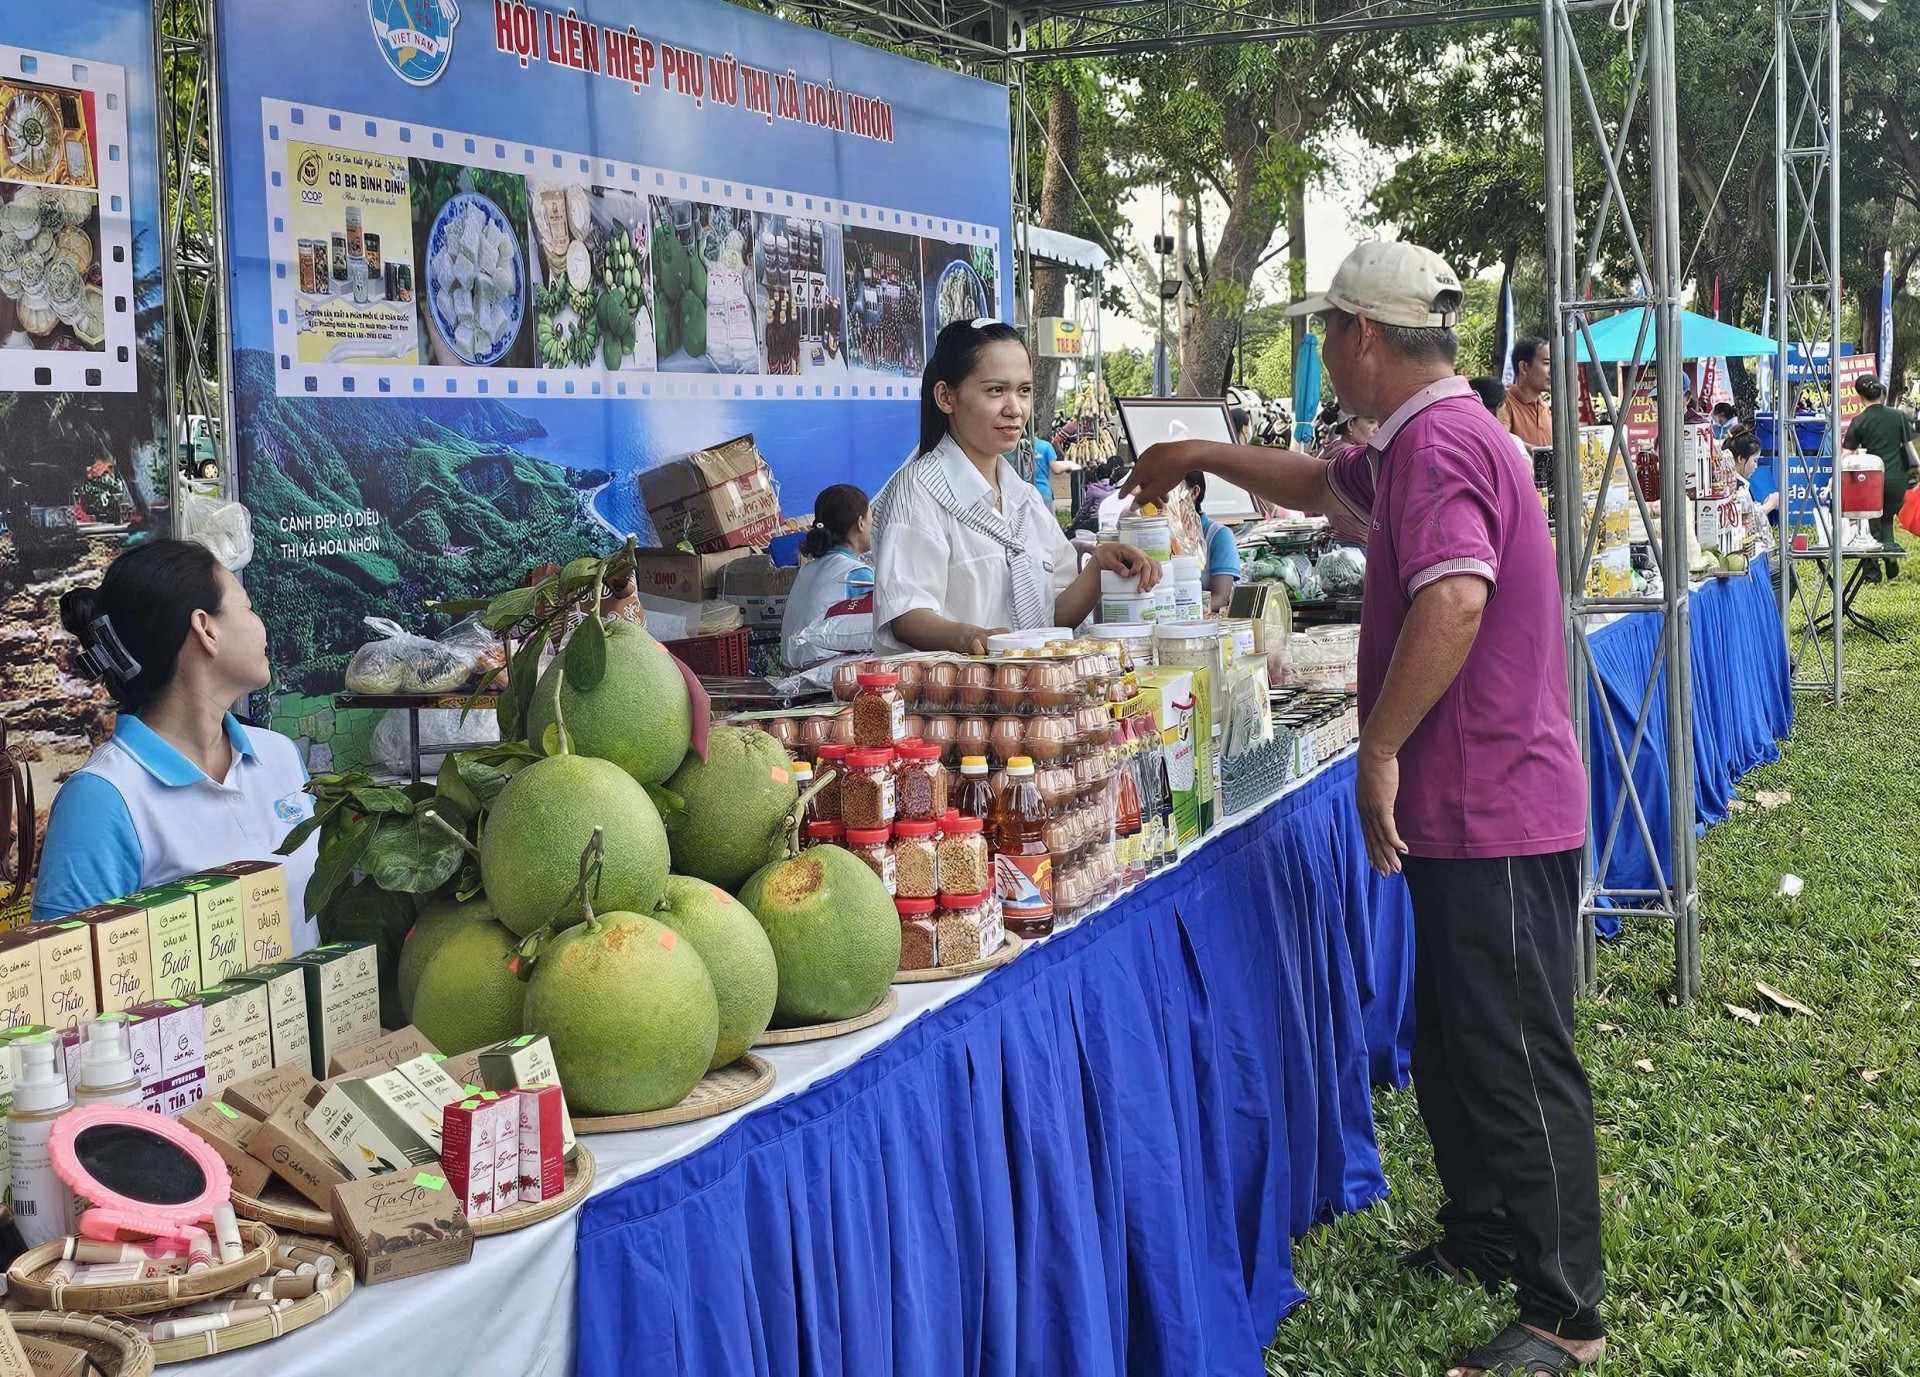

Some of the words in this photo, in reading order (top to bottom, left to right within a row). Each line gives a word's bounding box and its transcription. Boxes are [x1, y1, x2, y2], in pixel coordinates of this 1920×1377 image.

[414, 34, 434, 53] NAM
[544, 7, 600, 75] LIÊN
[604, 24, 656, 95] HIỆP
[661, 43, 704, 109] PHỤ
[708, 52, 738, 107] NỮ
[740, 65, 773, 125] THỊ
[774, 69, 801, 122] XÃ
[803, 79, 845, 132] HOÀI
[847, 96, 894, 143] NHƠN
[302, 190, 322, 201] OCOP
[328, 170, 342, 186] CÔ
[344, 174, 358, 188] BA
[360, 171, 382, 192] BÌNH
[384, 180, 406, 197] ĐỊNH
[280, 512, 312, 532] CẢNH
[315, 514, 336, 534] ĐẸP
[280, 543, 299, 562] THỊ
[302, 538, 316, 558] XÃ
[320, 536, 347, 556] HOÀI
[348, 536, 380, 552] NHƠN
[110, 968, 140, 996] Thảo
[52, 986, 84, 1015] Thảo
[169, 1092, 186, 1111] TÍA
[189, 1084, 203, 1103] TÔ
[329, 1125, 344, 1142] TINH
